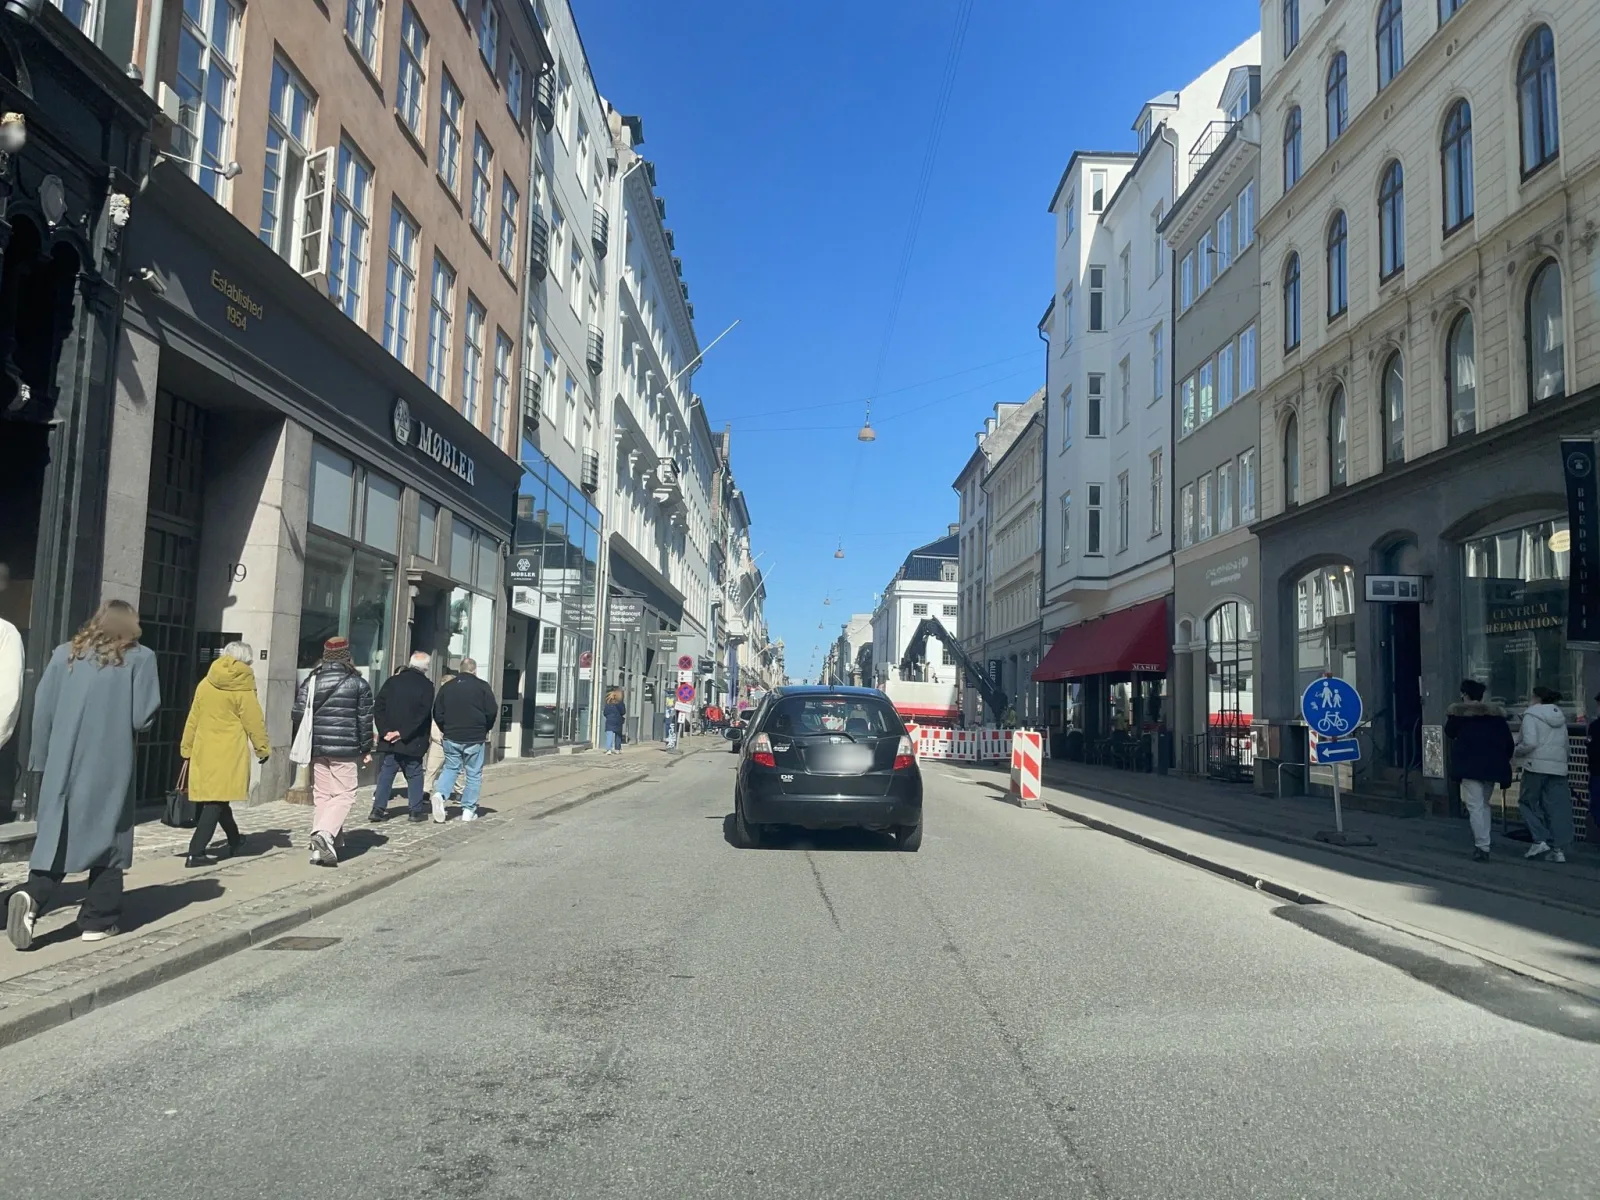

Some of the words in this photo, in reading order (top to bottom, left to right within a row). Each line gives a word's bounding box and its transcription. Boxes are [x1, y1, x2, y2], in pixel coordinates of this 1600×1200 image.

[211, 268, 263, 320] Established
[226, 305, 247, 331] 1954
[417, 419, 475, 486] MØBLER
[1577, 487, 1588, 594] BREDGADE
[227, 563, 247, 583] 19
[1493, 602, 1549, 620] CENTRUM
